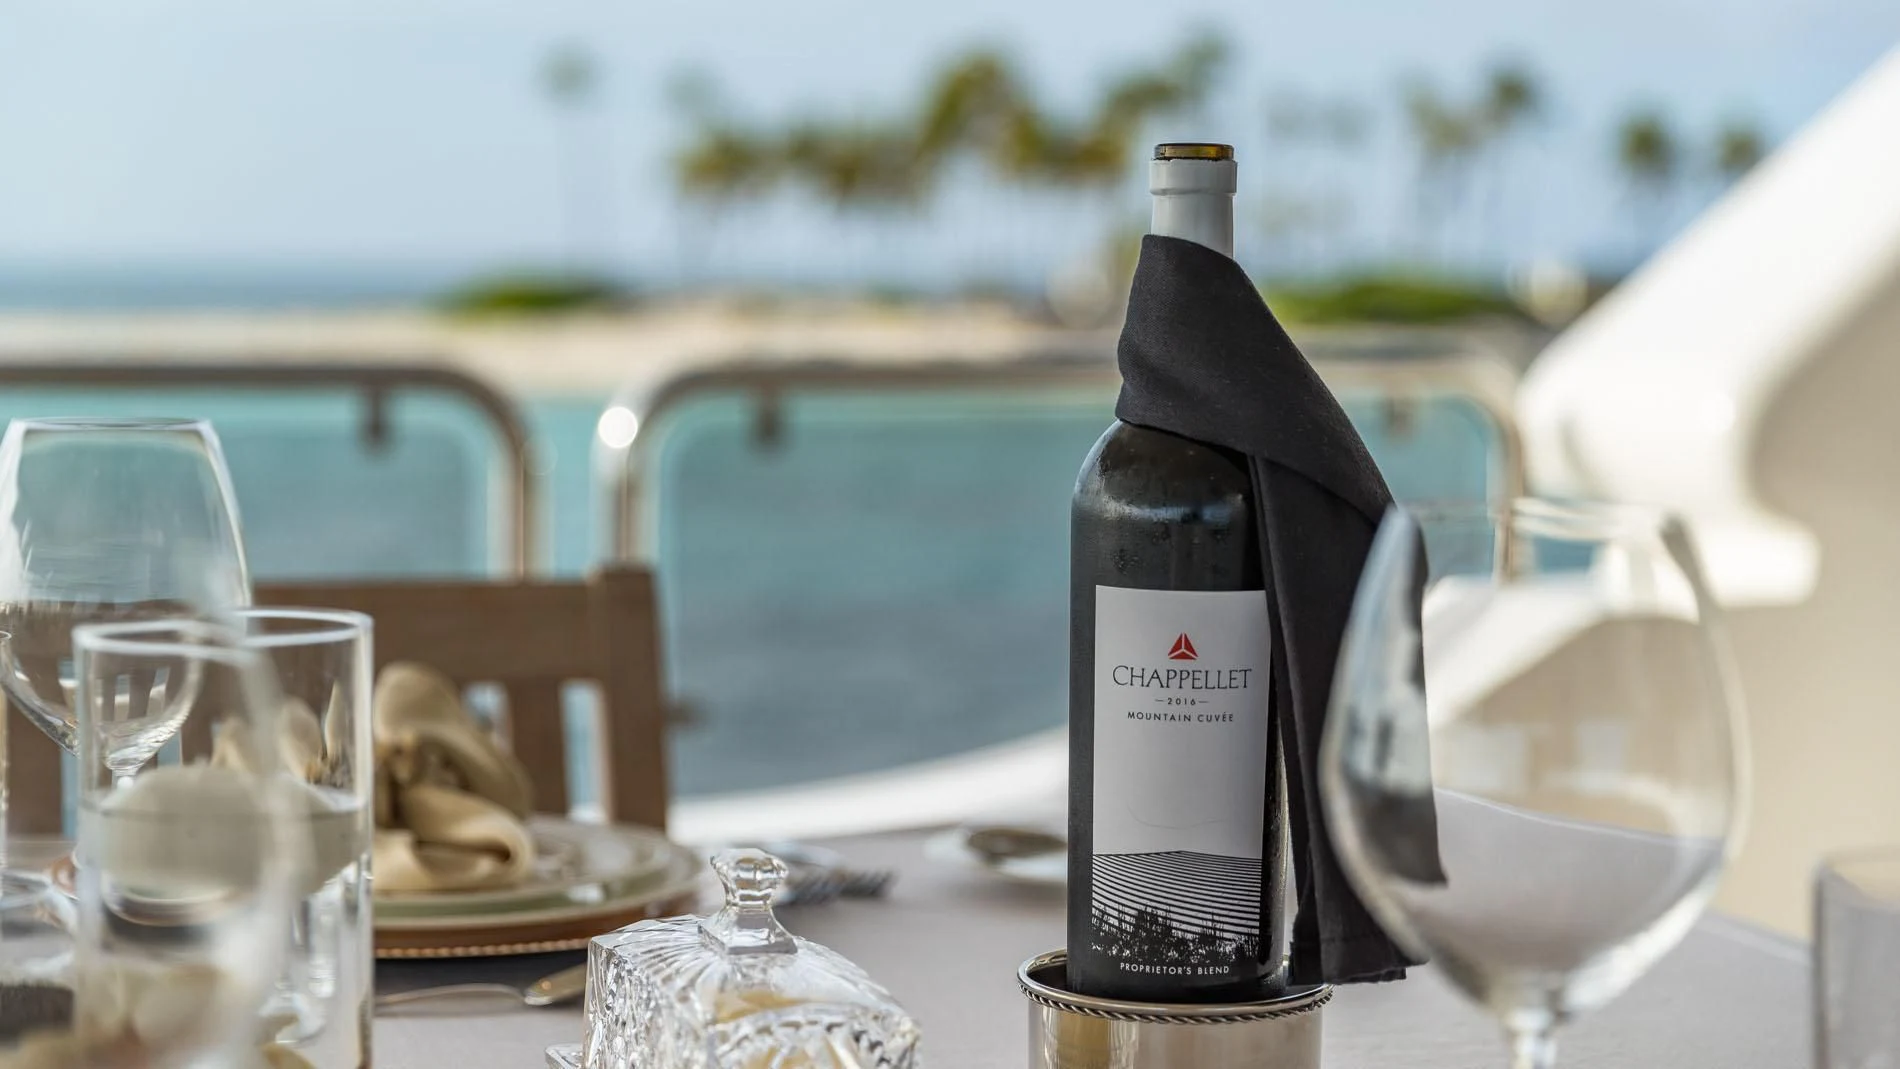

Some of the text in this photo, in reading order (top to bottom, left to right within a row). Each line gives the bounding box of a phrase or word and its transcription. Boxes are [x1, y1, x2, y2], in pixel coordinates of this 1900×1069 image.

[1112, 665, 1252, 690] CHAPPELLET
[1167, 697, 1196, 706] 2016
[1127, 711, 1234, 723] MOUNTAIN CUVÉE
[1119, 962, 1230, 975] PROPRIETOR'S BLEND
